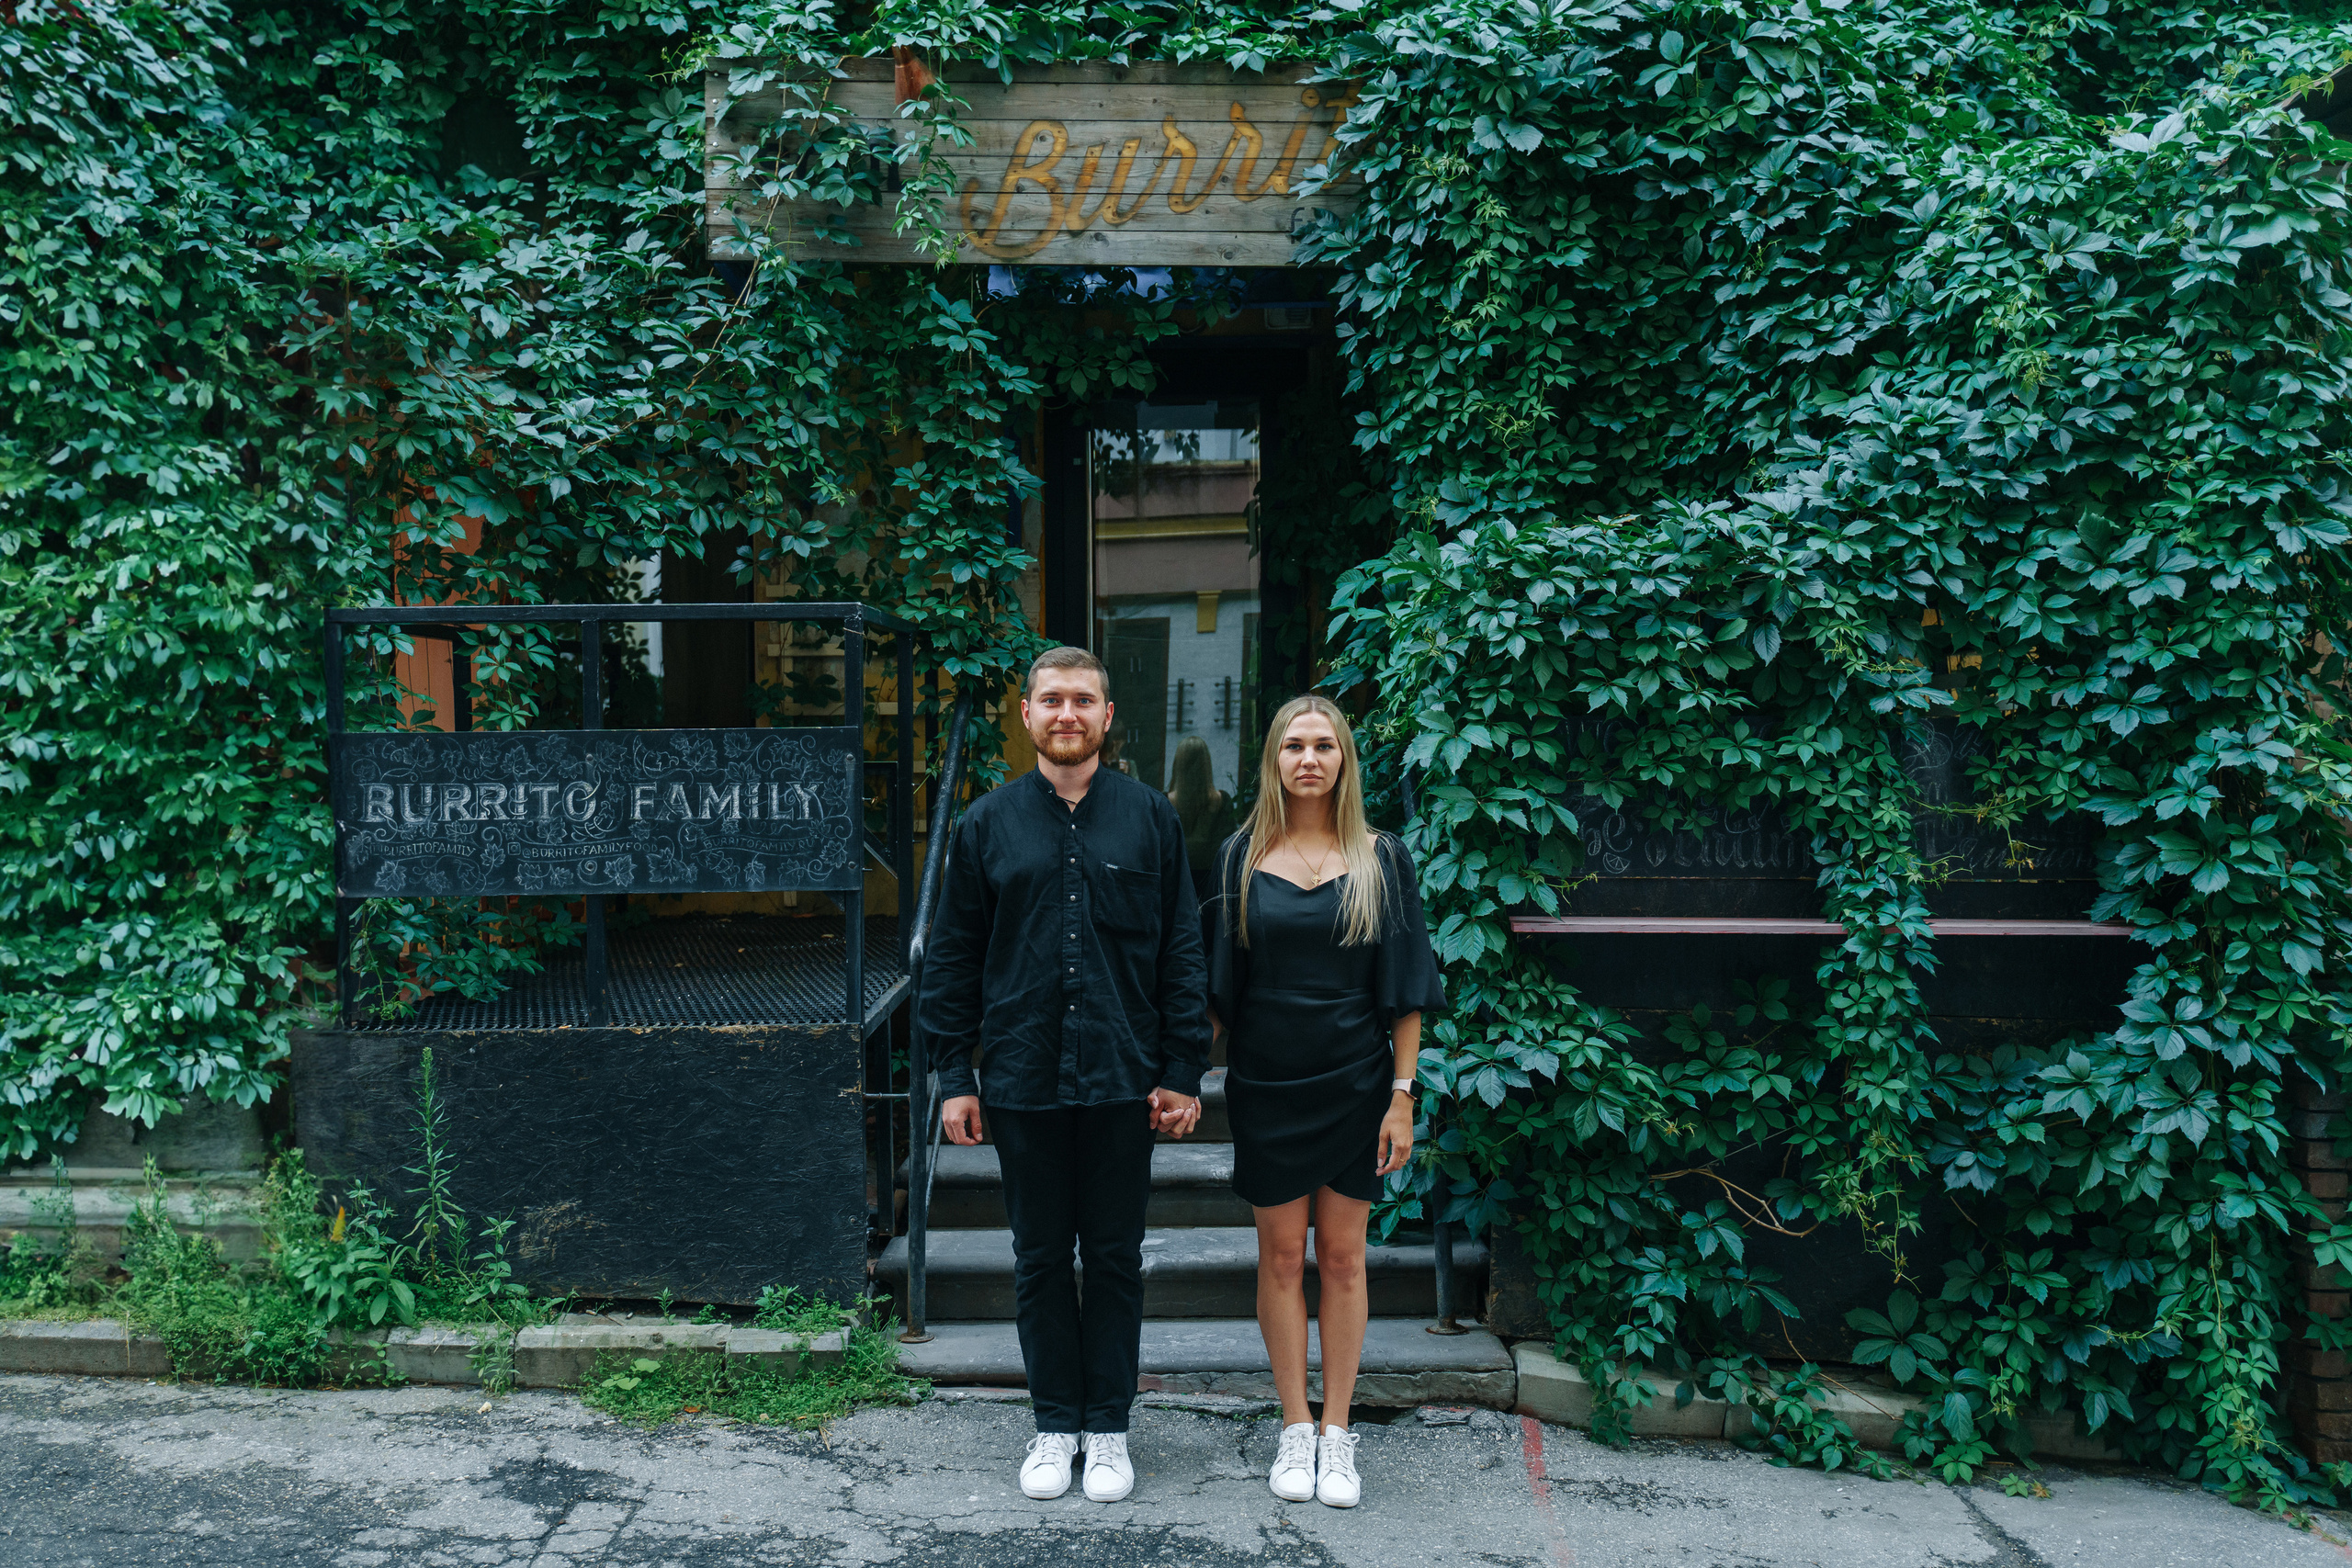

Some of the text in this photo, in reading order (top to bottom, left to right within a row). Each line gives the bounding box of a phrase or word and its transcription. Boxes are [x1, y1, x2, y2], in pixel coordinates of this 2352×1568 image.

[962, 78, 1373, 258] Burrit
[357, 781, 824, 824] BURRITO FAMILY
[522, 841, 658, 858] @BURRITOFAMILYFOOD
